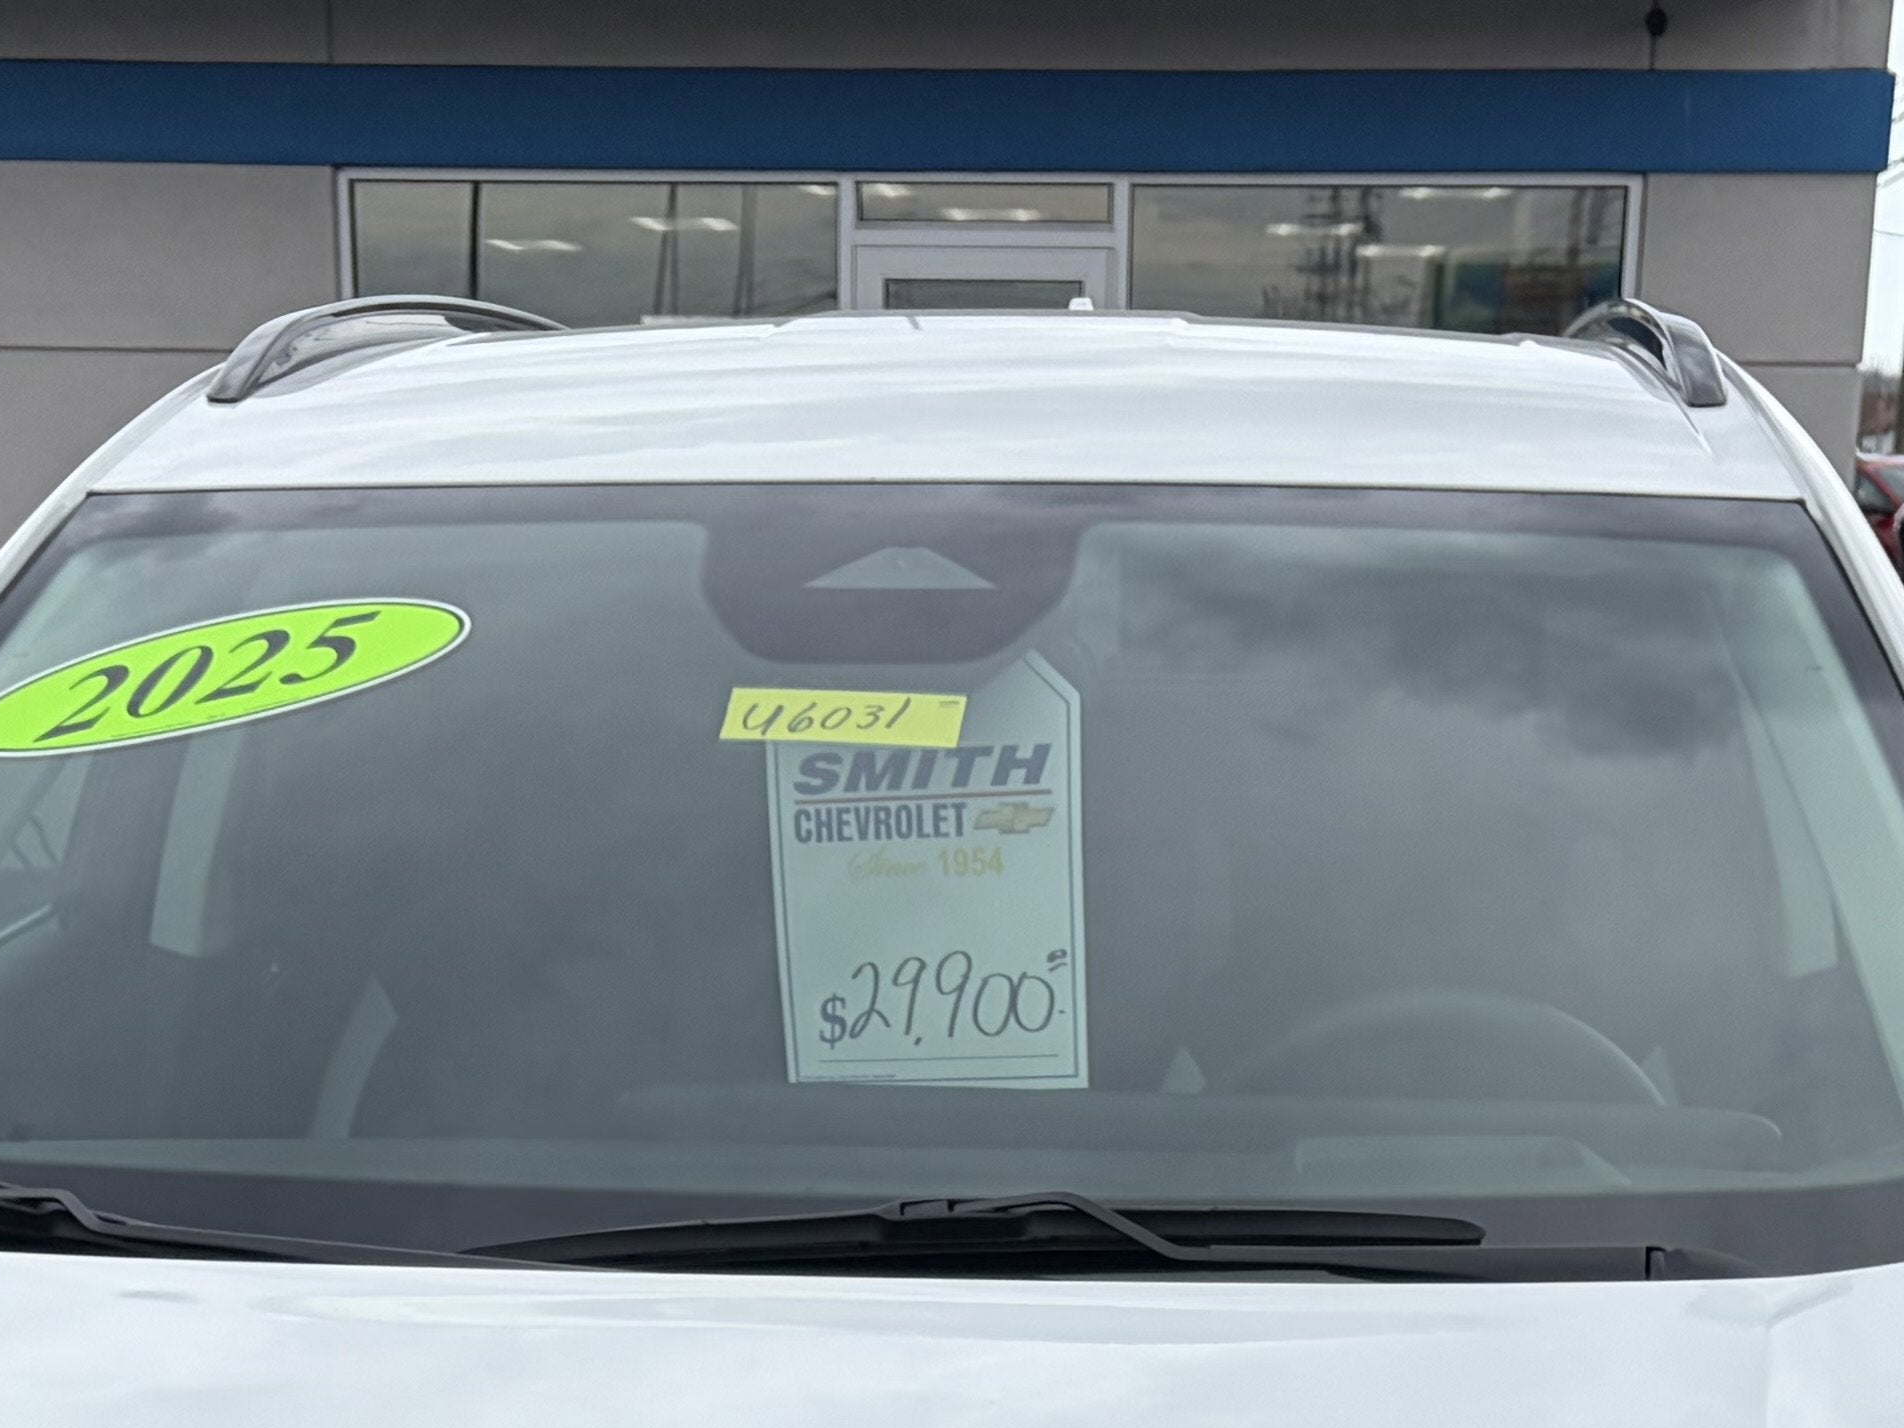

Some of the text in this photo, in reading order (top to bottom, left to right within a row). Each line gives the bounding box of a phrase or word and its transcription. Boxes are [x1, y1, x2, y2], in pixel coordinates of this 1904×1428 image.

[33, 611, 382, 742] 2025
[794, 743, 1052, 795] SMITH
[795, 803, 967, 844] CHEVROLET
[938, 847, 1004, 878] 1954
